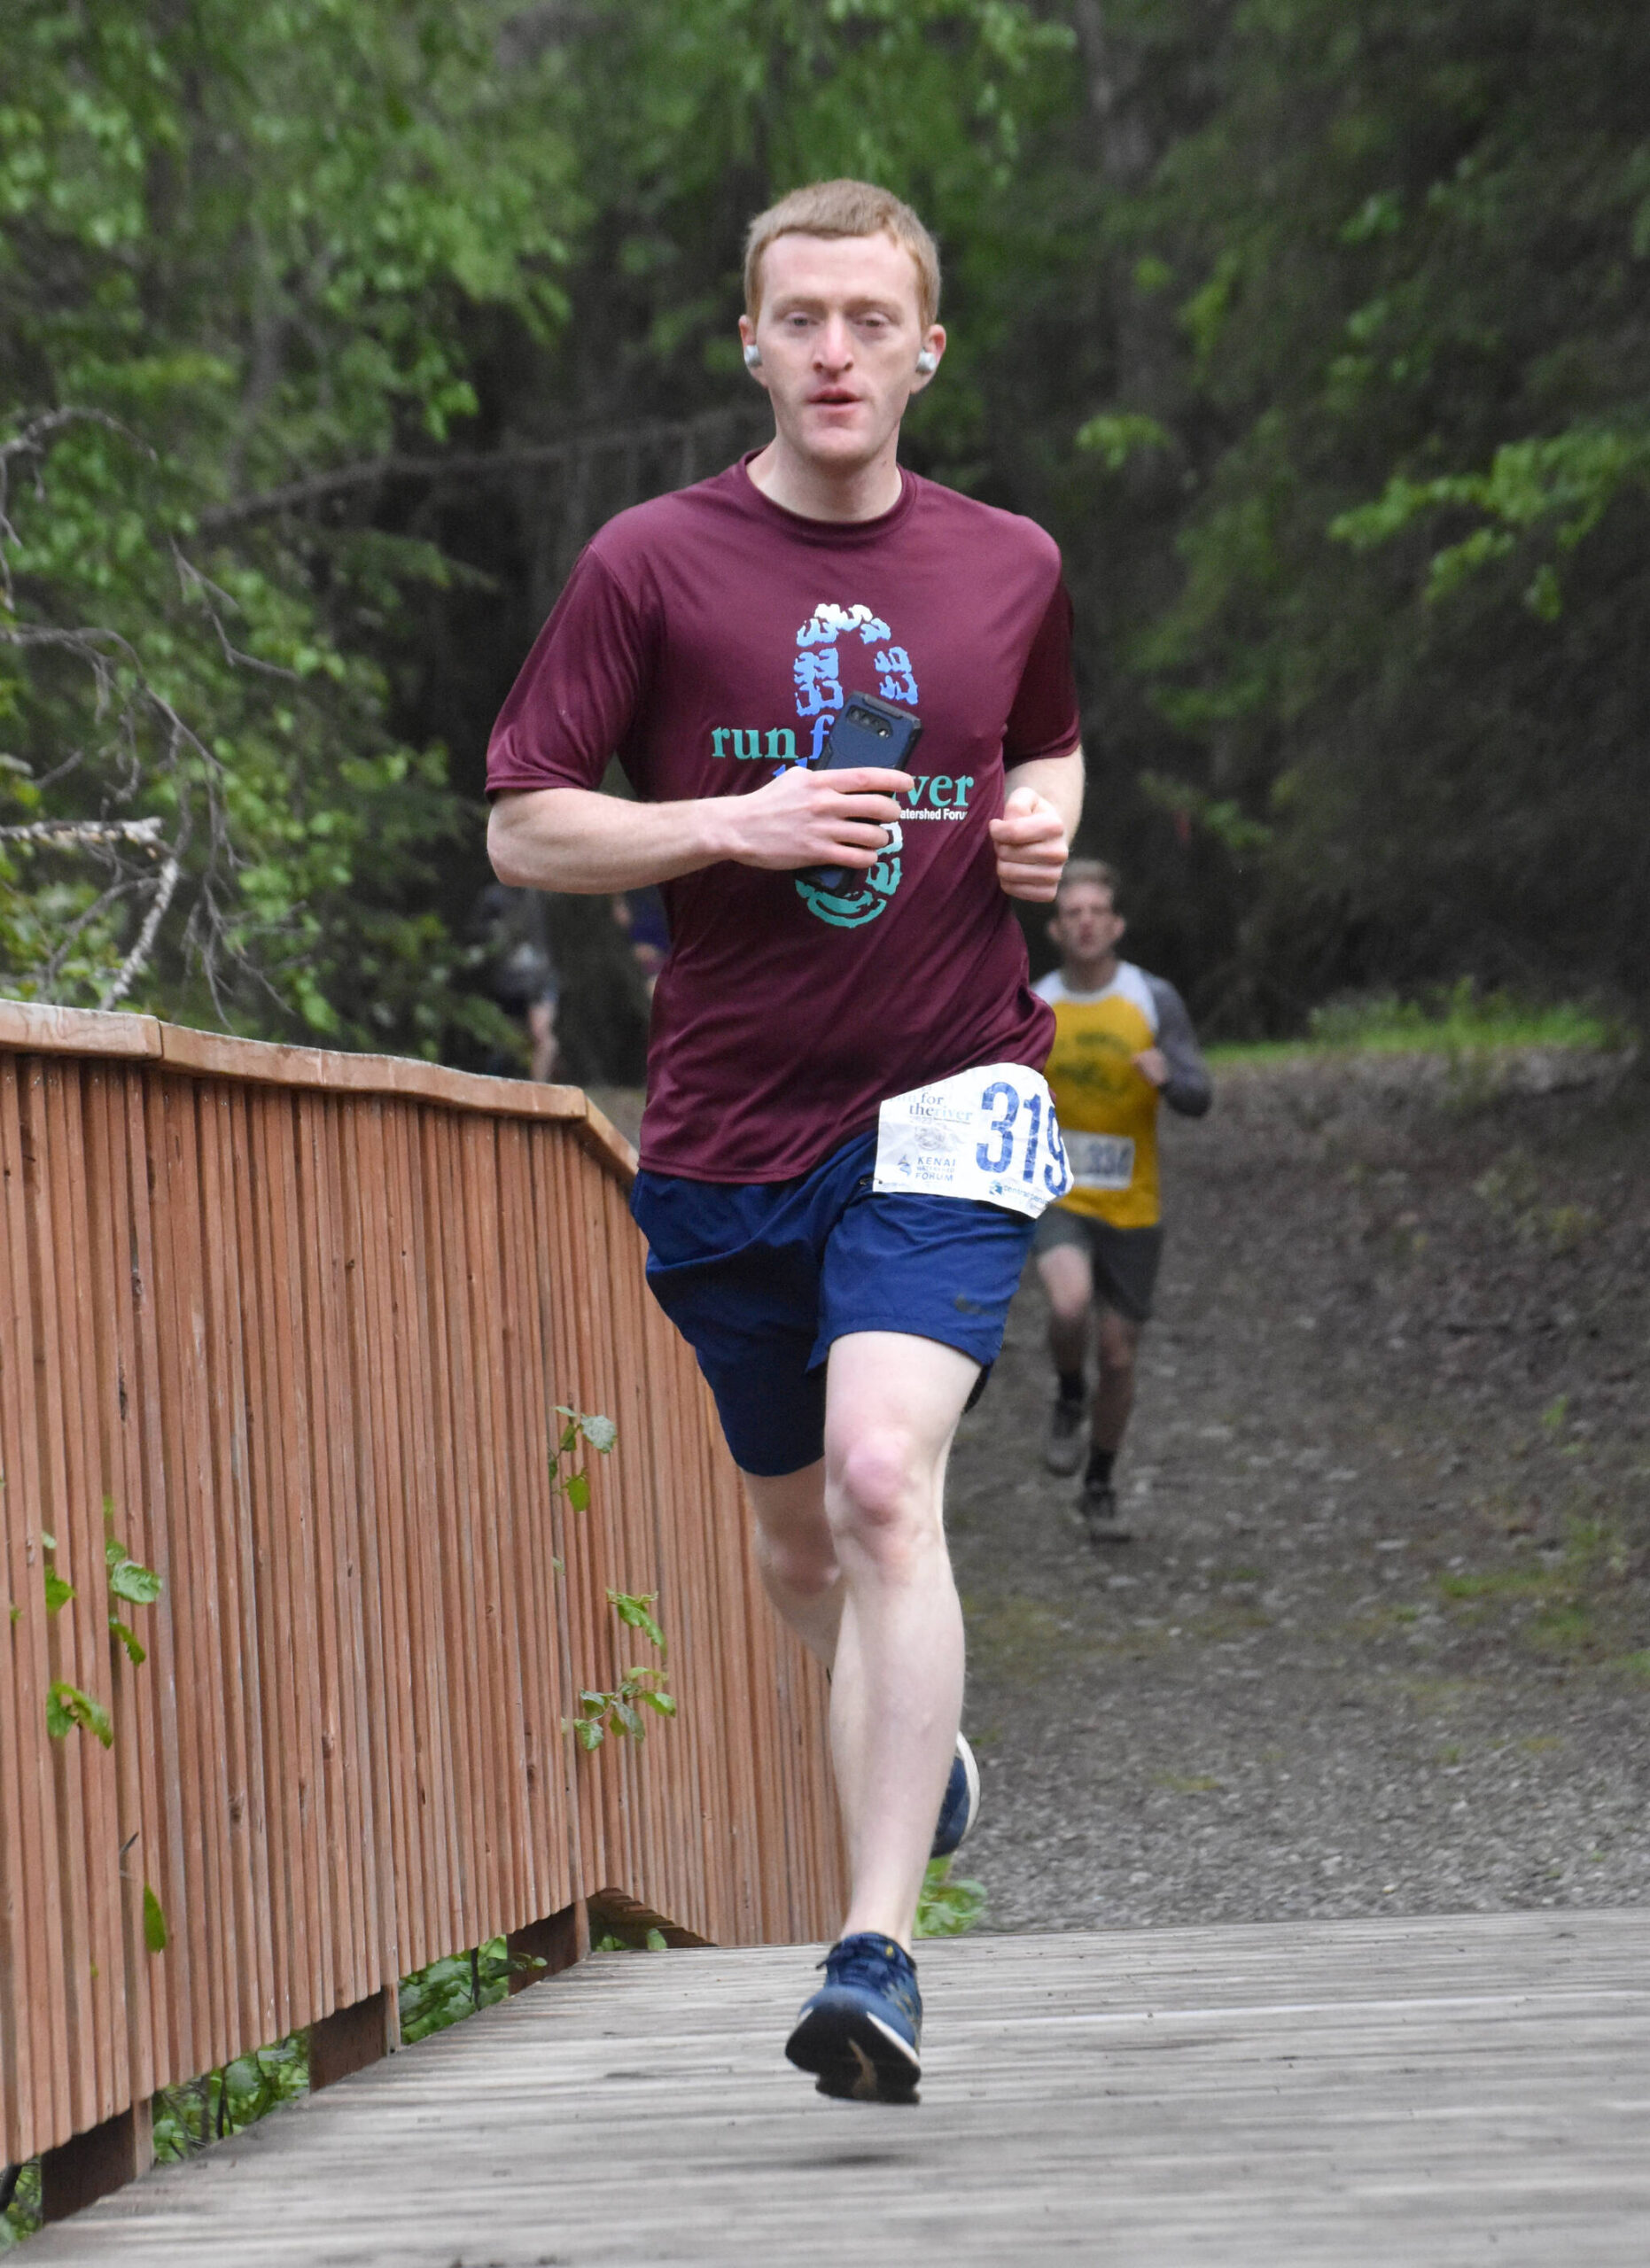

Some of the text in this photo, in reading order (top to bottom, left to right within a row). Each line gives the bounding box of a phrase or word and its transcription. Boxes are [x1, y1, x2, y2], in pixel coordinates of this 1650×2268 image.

[711, 726, 798, 759] run
[892, 774, 975, 807] ver
[899, 807, 942, 820] atershed
[921, 1091, 944, 1105] for
[976, 1081, 1068, 1197] 319
[917, 1156, 956, 1167] KENAI
[915, 1171, 953, 1182] FORUM
